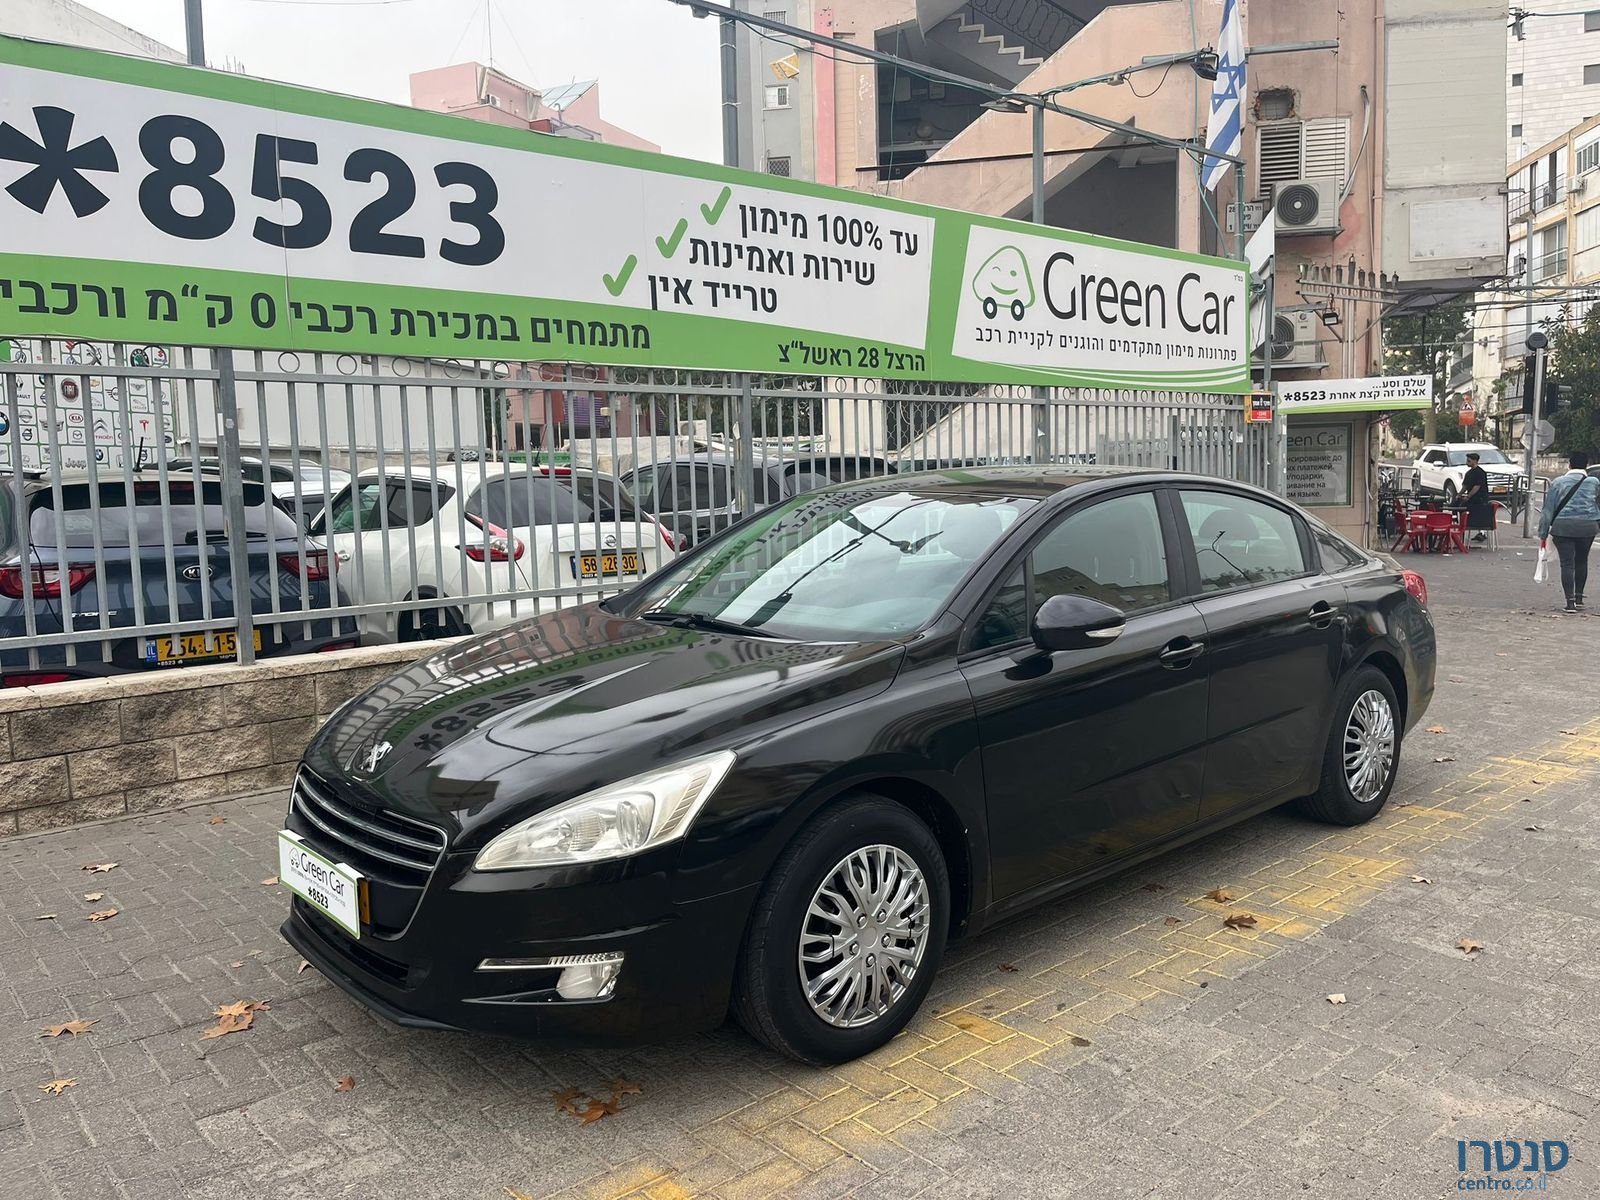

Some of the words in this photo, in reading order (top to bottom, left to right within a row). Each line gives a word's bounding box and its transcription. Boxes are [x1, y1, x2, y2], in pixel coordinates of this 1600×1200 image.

[738, 203, 809, 239] מימון
[817, 214, 883, 250] 100%
[889, 229, 918, 256] עד
[688, 237, 795, 277] ואמינות
[802, 253, 876, 286] שירות
[647, 274, 694, 311] אין
[702, 280, 778, 314] טרייד
[1042, 251, 1167, 330] Green
[1176, 272, 1235, 336] Car
[249, 291, 277, 329] 0
[287, 300, 378, 335] רכבי
[390, 307, 521, 343] במכירת
[530, 316, 651, 350] מתמחים
[975, 327, 1002, 343] רכב
[1007, 330, 1054, 350] לקניית
[1059, 334, 1104, 351] והוגנים
[1109, 338, 1163, 355] מתקדמים
[1165, 343, 1194, 360] מימון
[857, 346, 880, 368] 28
[884, 347, 926, 371] הרצל
[1197, 346, 1237, 362] פתרונות
[1383, 388, 1394, 397] זה
[1397, 388, 1426, 397] אצלנו
[1403, 378, 1426, 387] שלם
[1329, 391, 1357, 400] אחרת
[1359, 390, 1380, 400] קצת
[1287, 435, 1313, 447] een
[1316, 431, 1343, 446] Car
[300, 852, 328, 886] Green
[329, 870, 344, 897] Car
